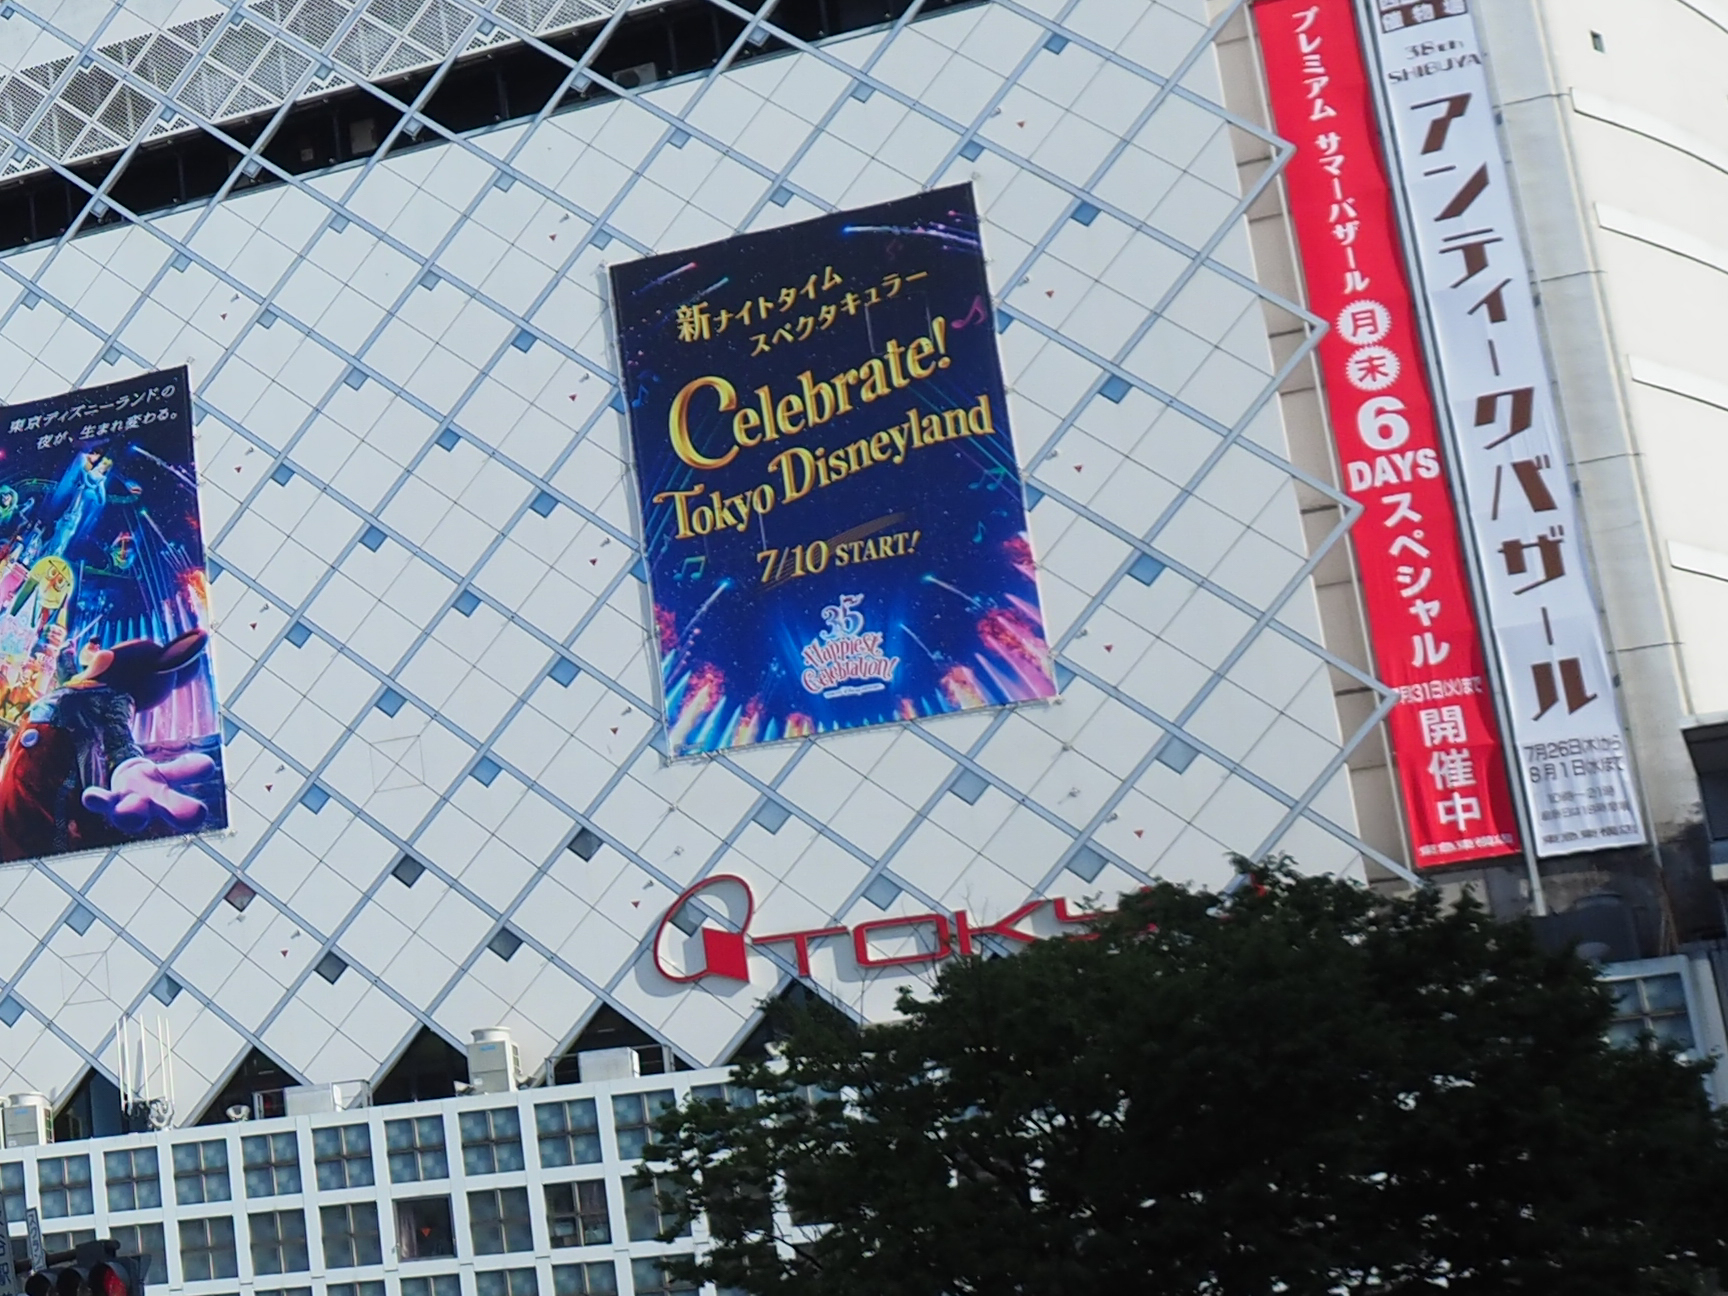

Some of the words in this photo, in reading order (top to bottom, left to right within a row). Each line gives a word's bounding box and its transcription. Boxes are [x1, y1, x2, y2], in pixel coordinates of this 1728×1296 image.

[1290, 4, 1340, 123] プレミアム
[1387, 52, 1482, 85] SHIBUYA
[1316, 132, 1370, 294] サマーバザール
[674, 264, 845, 344] 新ナイトタイム
[749, 270, 928, 357] スペクタキュラー
[1343, 307, 1393, 388] 月末
[7, 383, 176, 435] 東京ディズニーランドの
[36, 408, 179, 451] 夜が、生まれ変わる。
[666, 315, 954, 471] Celebrate!
[1357, 396, 1410, 451] 6
[1406, 90, 1598, 722] アンティークバザール
[652, 481, 774, 540] Tokyo
[766, 396, 996, 507] Disneyland
[1347, 448, 1441, 495] DAYS
[755, 539, 830, 585] 7/10
[834, 530, 922, 568] START!
[1380, 493, 1451, 670] スペシャル
[801, 631, 884, 670] Happiest
[1392, 675, 1484, 704] 月31日(火)まで
[1418, 704, 1482, 833] 開催中
